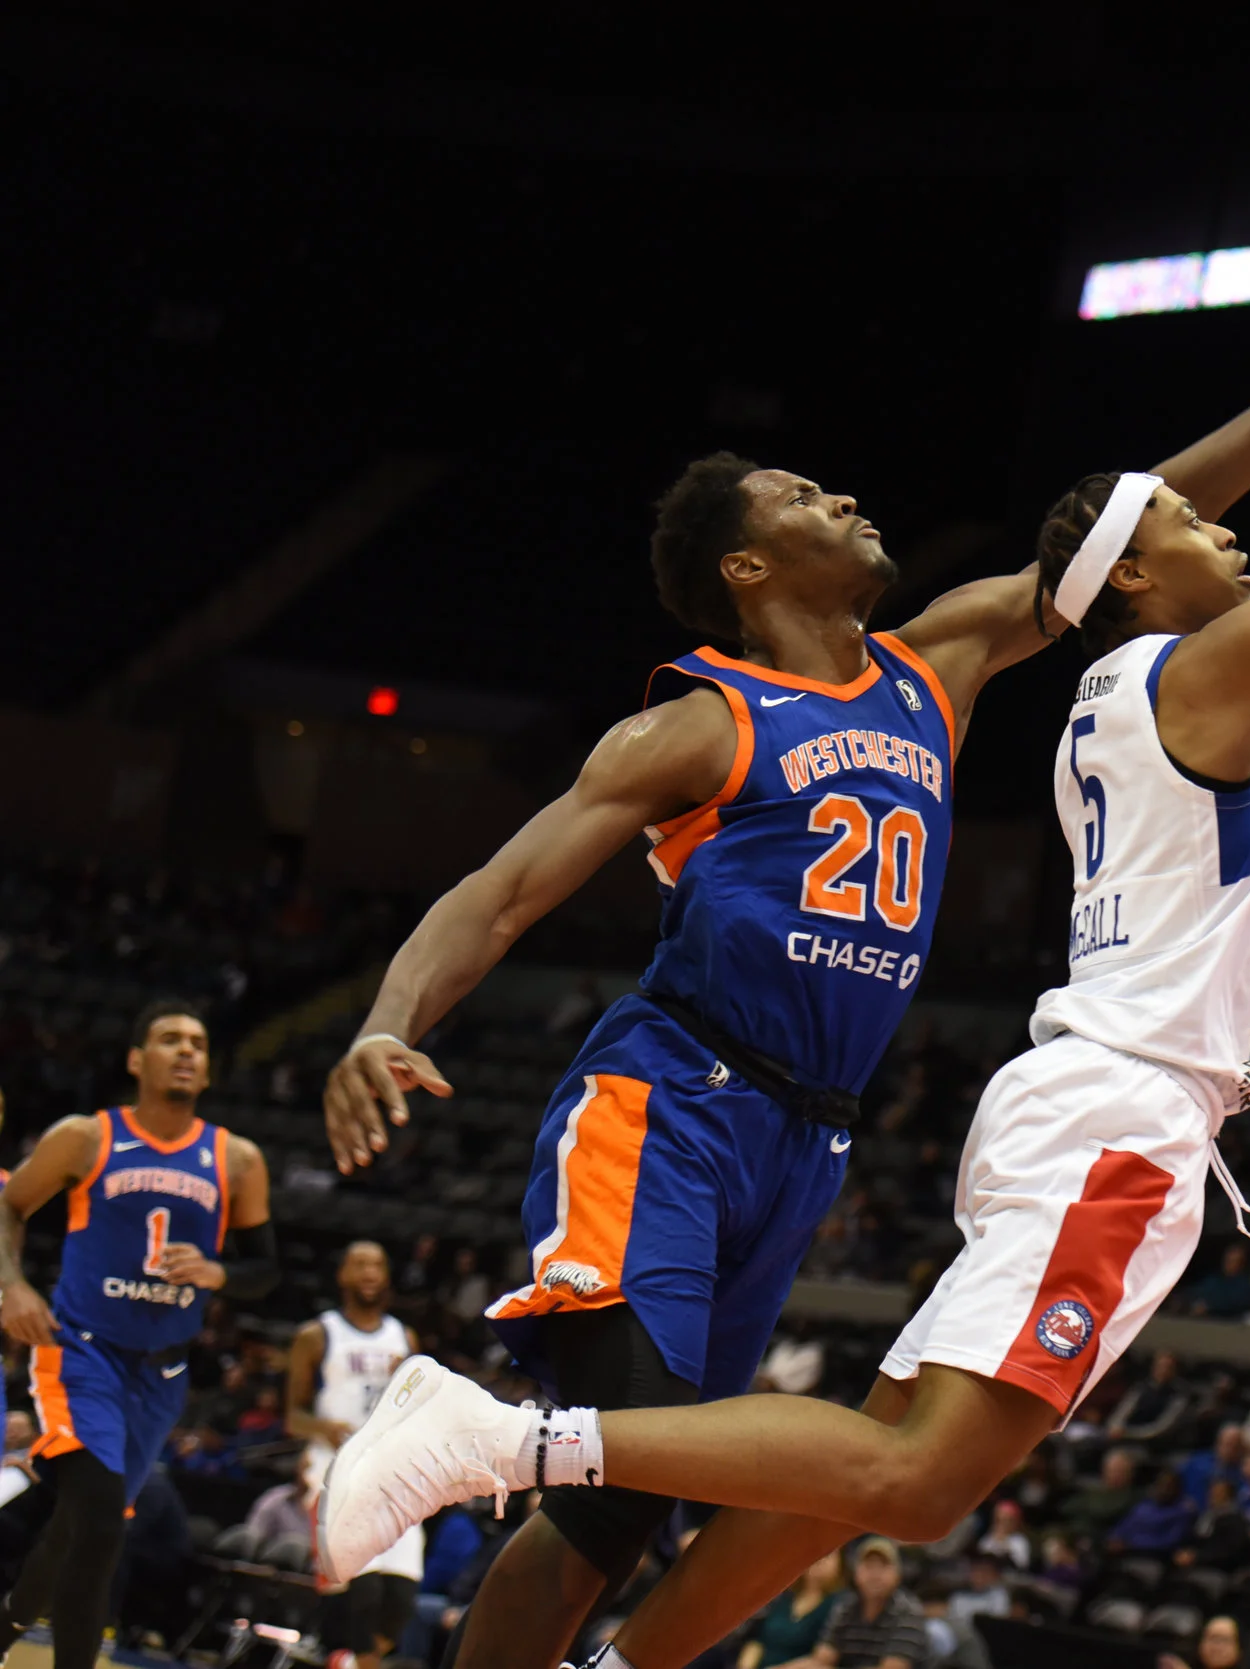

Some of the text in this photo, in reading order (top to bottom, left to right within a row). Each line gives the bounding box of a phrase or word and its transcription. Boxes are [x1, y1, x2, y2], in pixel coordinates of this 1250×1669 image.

[779, 729, 942, 803] WESTCHESTER
[1071, 713, 1106, 880] 5
[800, 793, 928, 933] 20
[787, 932, 900, 981] CHASE
[143, 1206, 171, 1277] 1
[103, 1277, 179, 1305] CHASE
